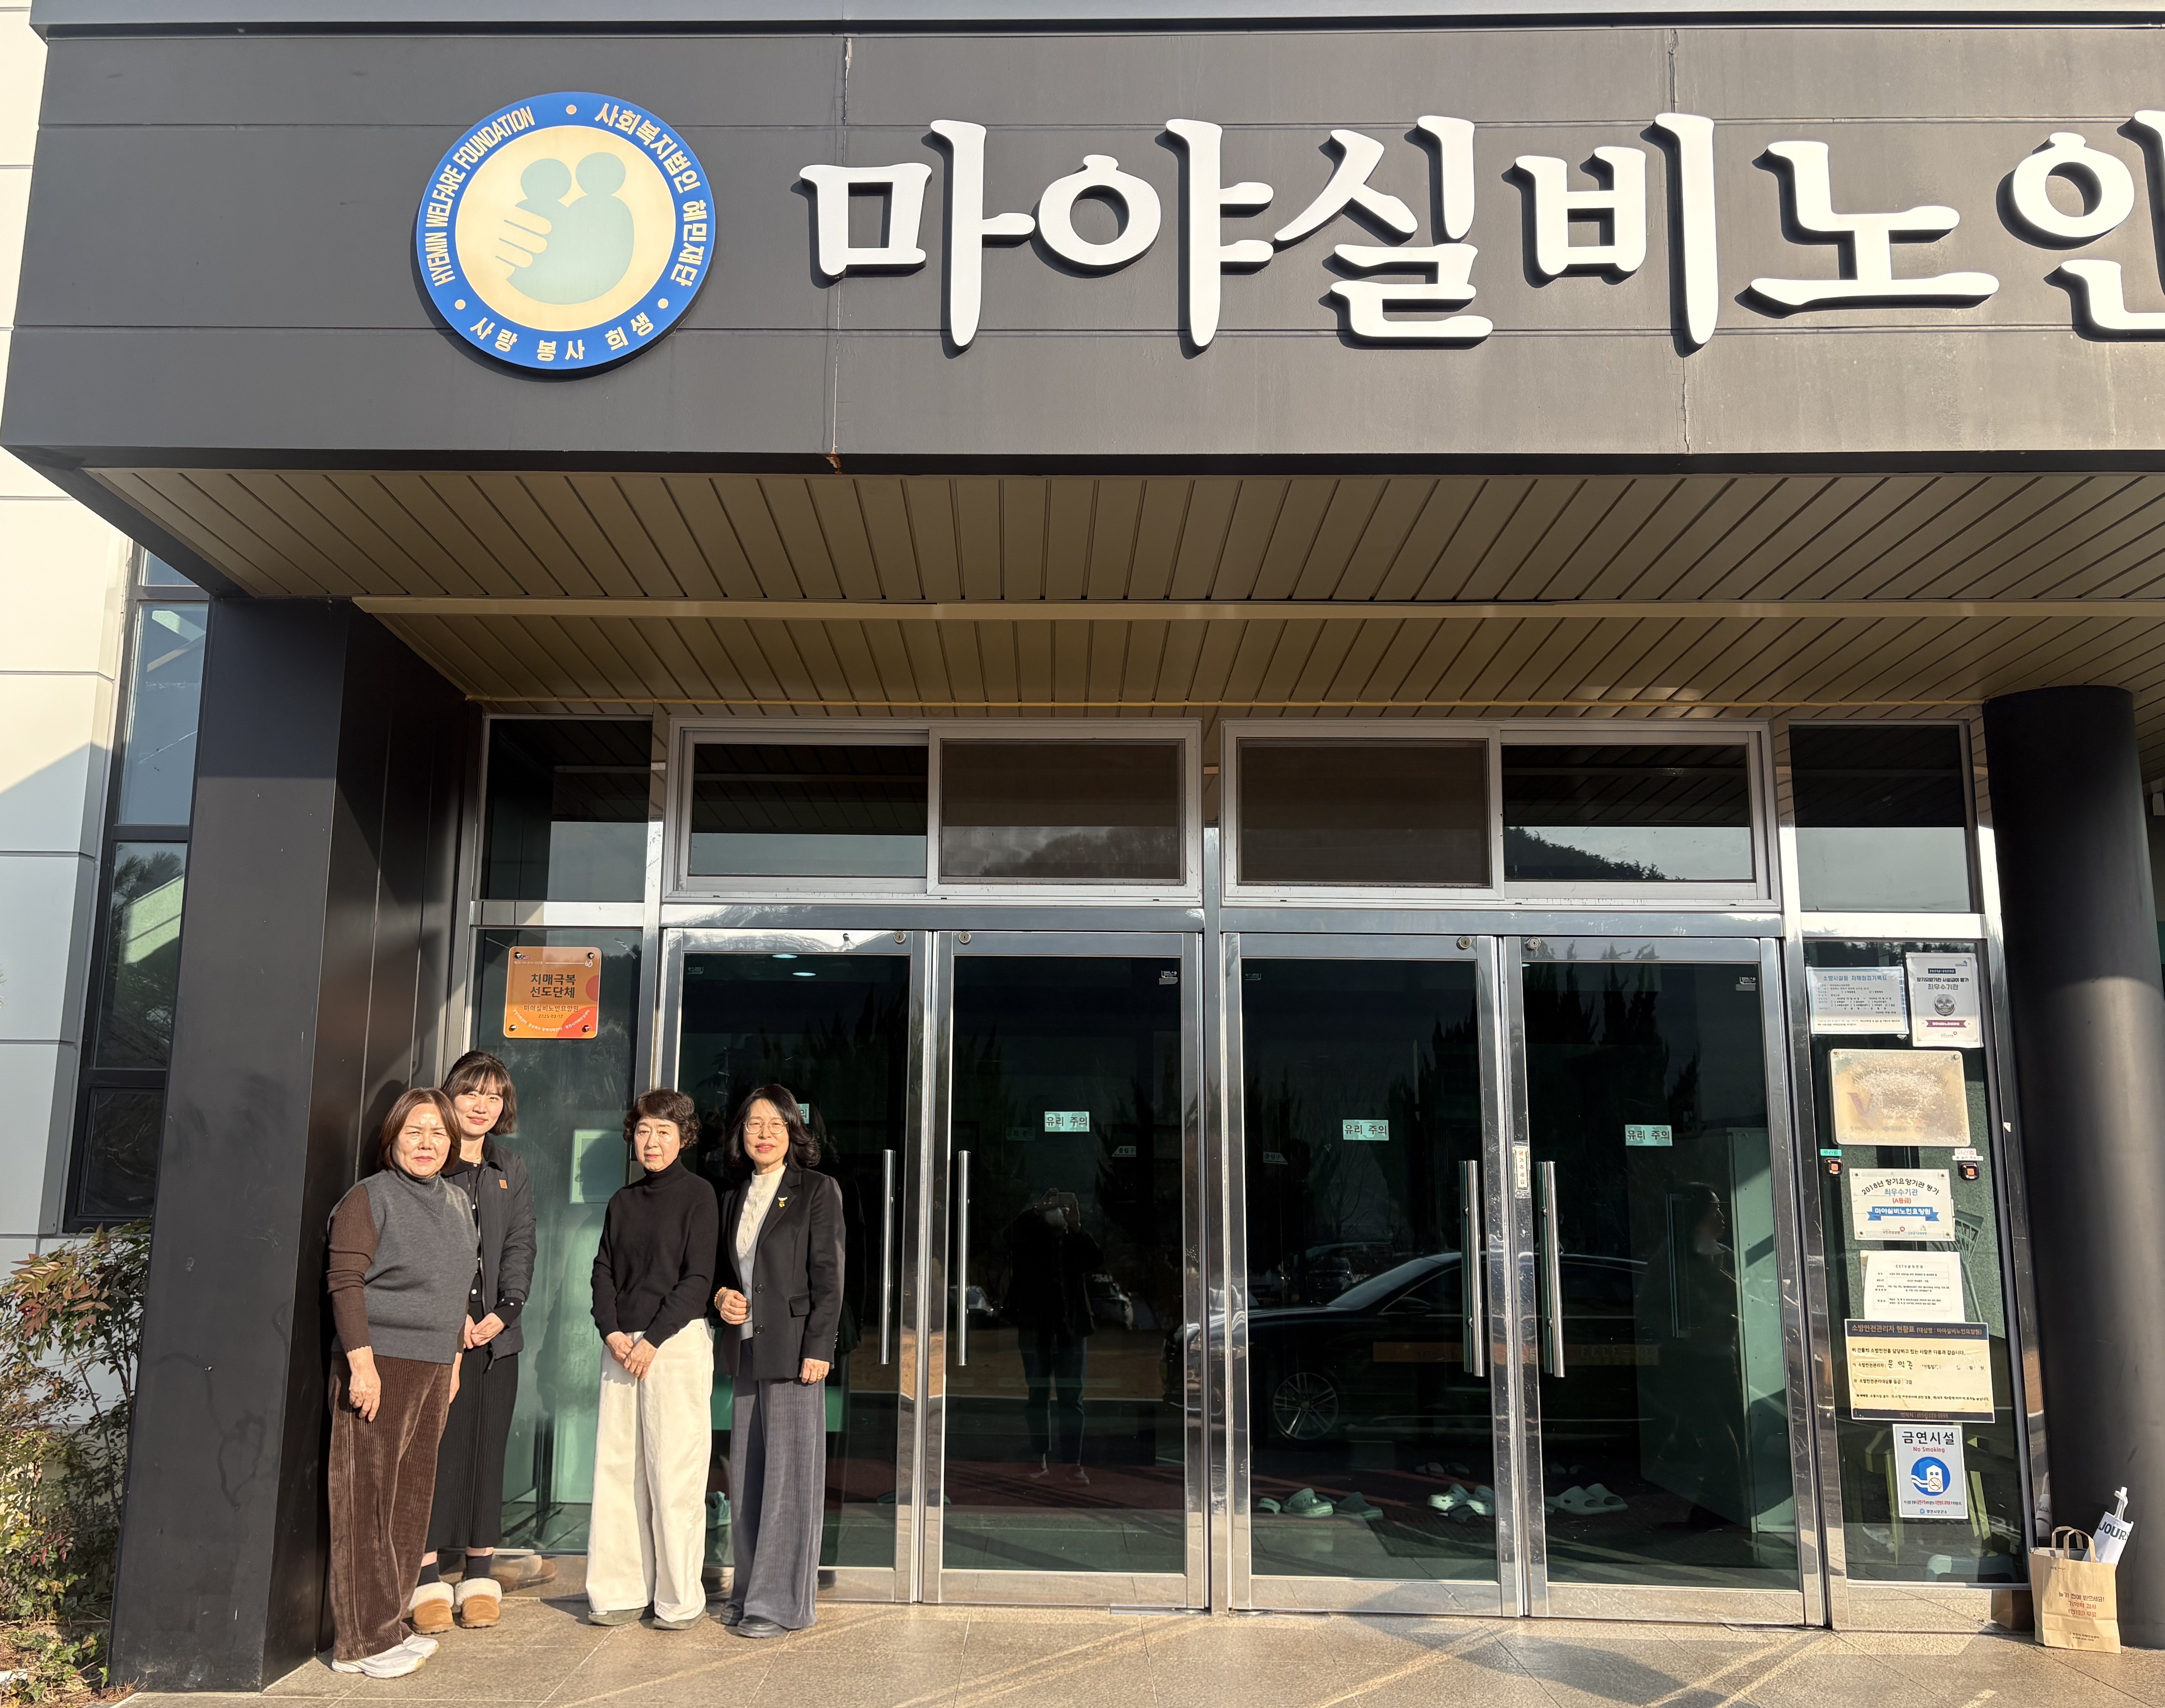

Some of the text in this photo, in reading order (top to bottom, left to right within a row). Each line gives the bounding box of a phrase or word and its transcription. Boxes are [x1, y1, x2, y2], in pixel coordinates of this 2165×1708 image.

[425, 106, 535, 287] HYEMIN WELFARE FOUNDATION
[594, 103, 707, 287] 사회복지법인 혜민재단
[470, 311, 654, 362] 사랑 봉사 희생
[531, 973, 576, 986] 치매극복
[530, 986, 575, 998] 선도단체
[1046, 1116, 1088, 1128] 유리 주의
[1344, 1124, 1387, 1135] 유리 주의
[1627, 1129, 1670, 1140] 유리 주의
[1862, 1178, 1939, 1195] 2018년 장기요양기관 평가
[1884, 1188, 1918, 1196] 최우수기관
[1852, 1324, 1895, 1333] 소방안전관리자
[1896, 1325, 1915, 1333] 현황표
[1902, 1431, 1955, 1446] 금연시설
[2068, 1600, 2085, 1608] 기억력
